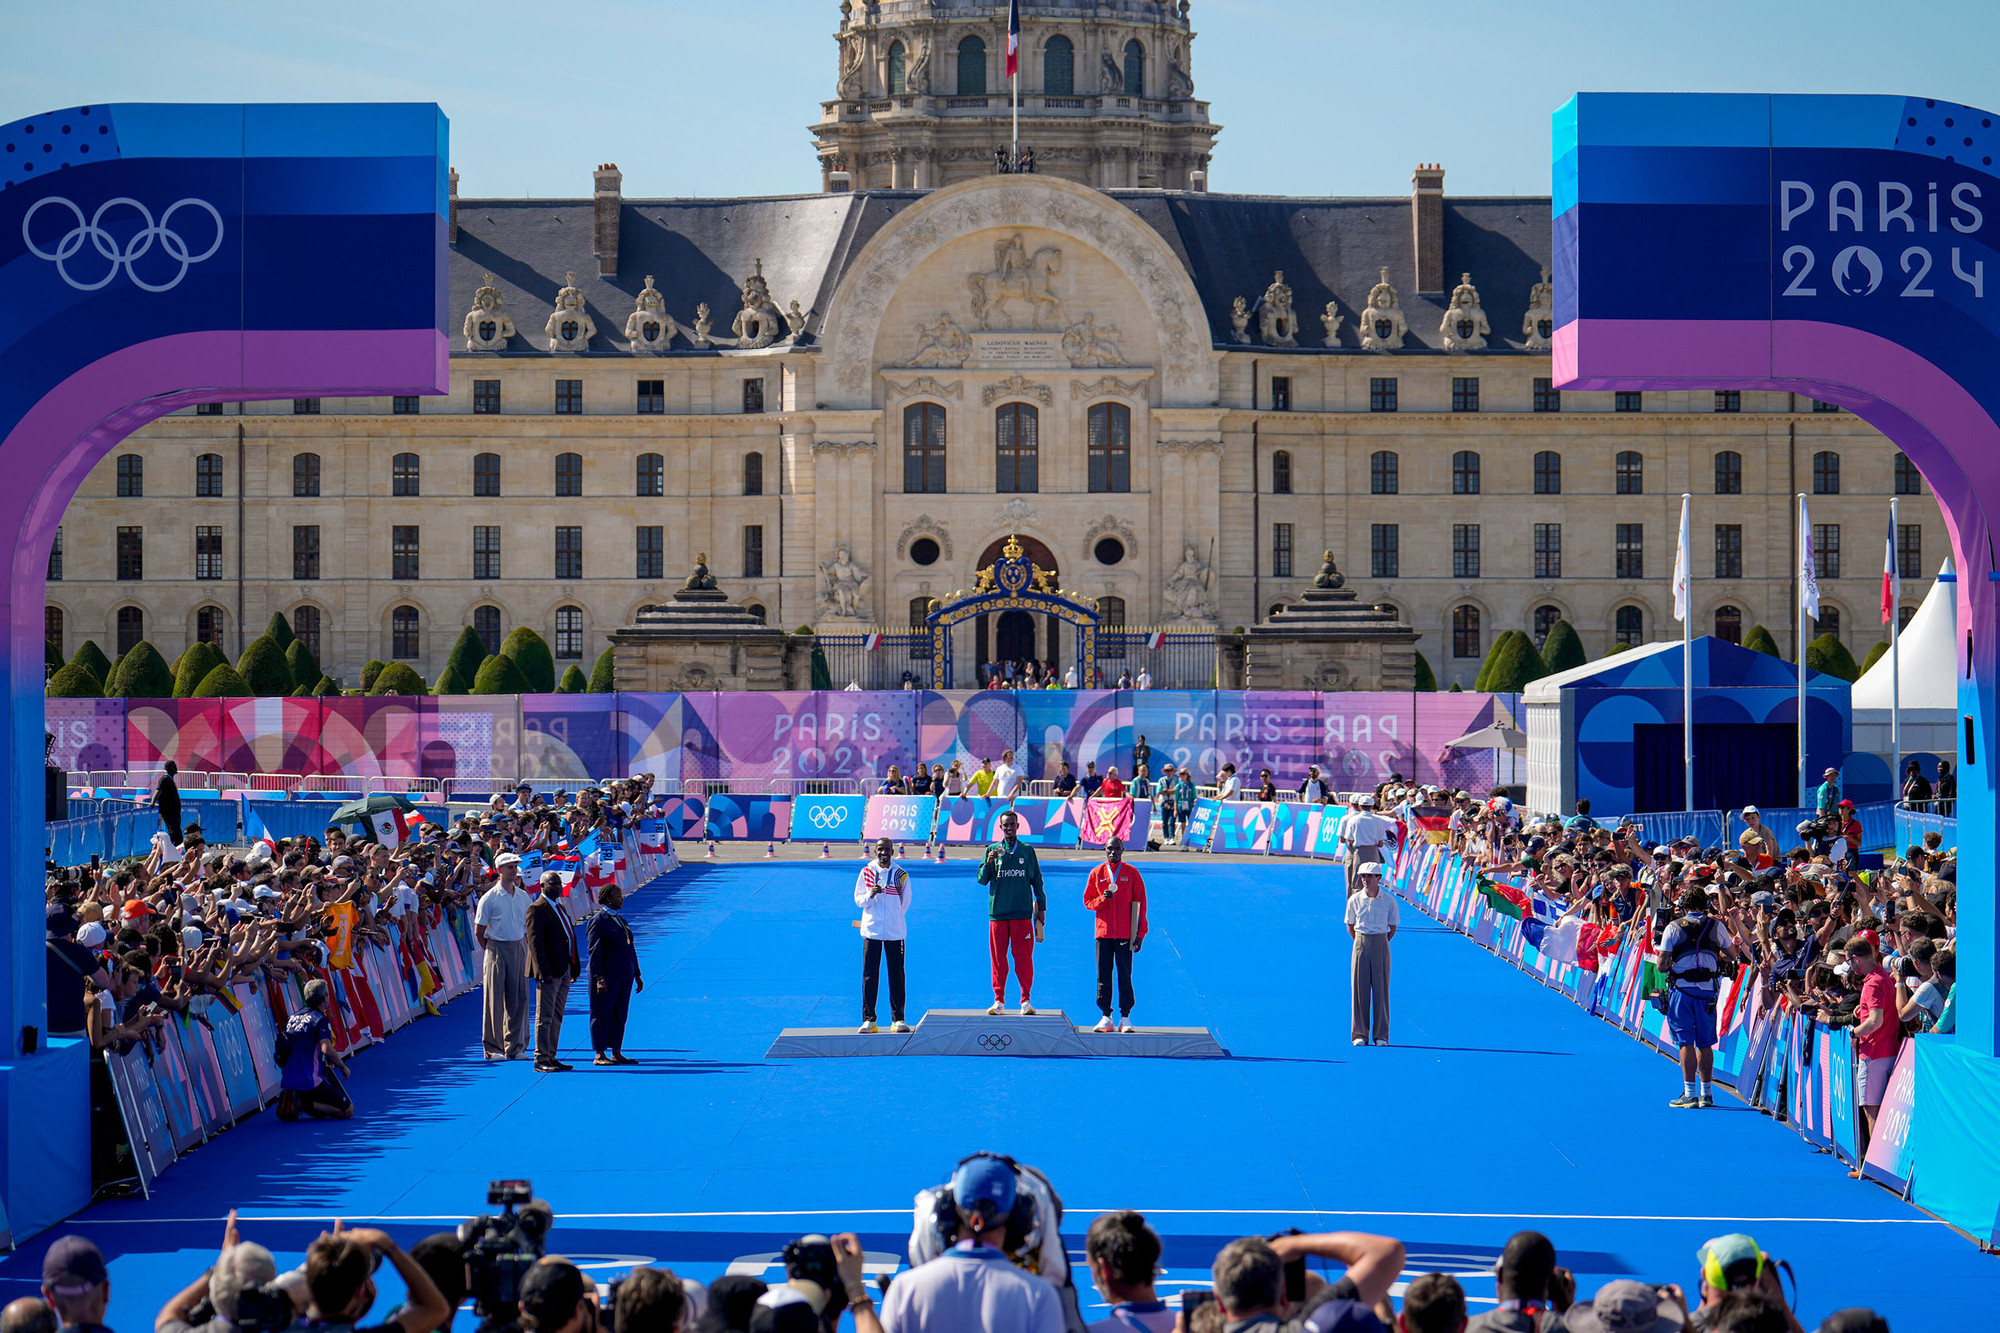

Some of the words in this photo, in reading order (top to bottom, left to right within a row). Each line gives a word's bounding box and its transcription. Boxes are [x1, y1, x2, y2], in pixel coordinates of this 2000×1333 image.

[1782, 245, 1983, 298] 2024
[773, 747, 879, 775] 2024
[880, 818, 916, 831] 2024
